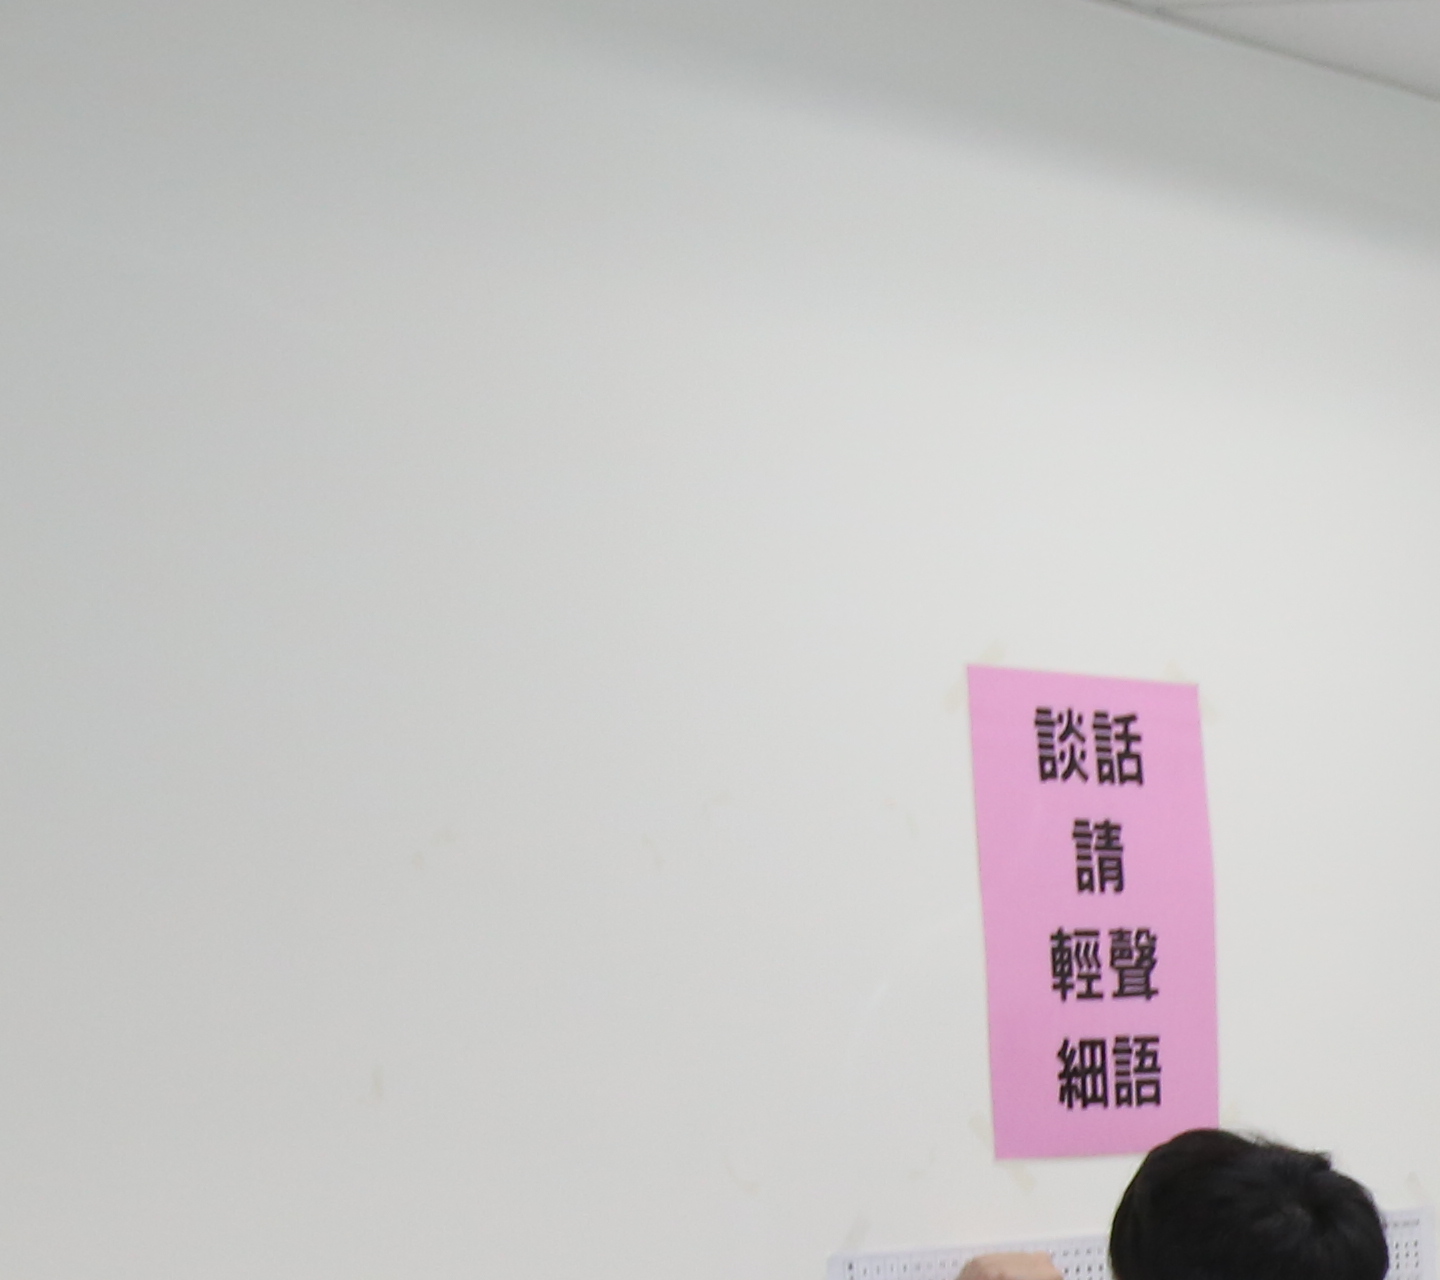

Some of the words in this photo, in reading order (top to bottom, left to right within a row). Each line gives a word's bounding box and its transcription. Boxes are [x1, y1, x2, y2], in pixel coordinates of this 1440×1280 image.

[1033, 706, 1144, 786] 談話
[1072, 819, 1125, 894] 請
[1050, 927, 1159, 1003] 輕聲
[1057, 1035, 1162, 1109] 細語
